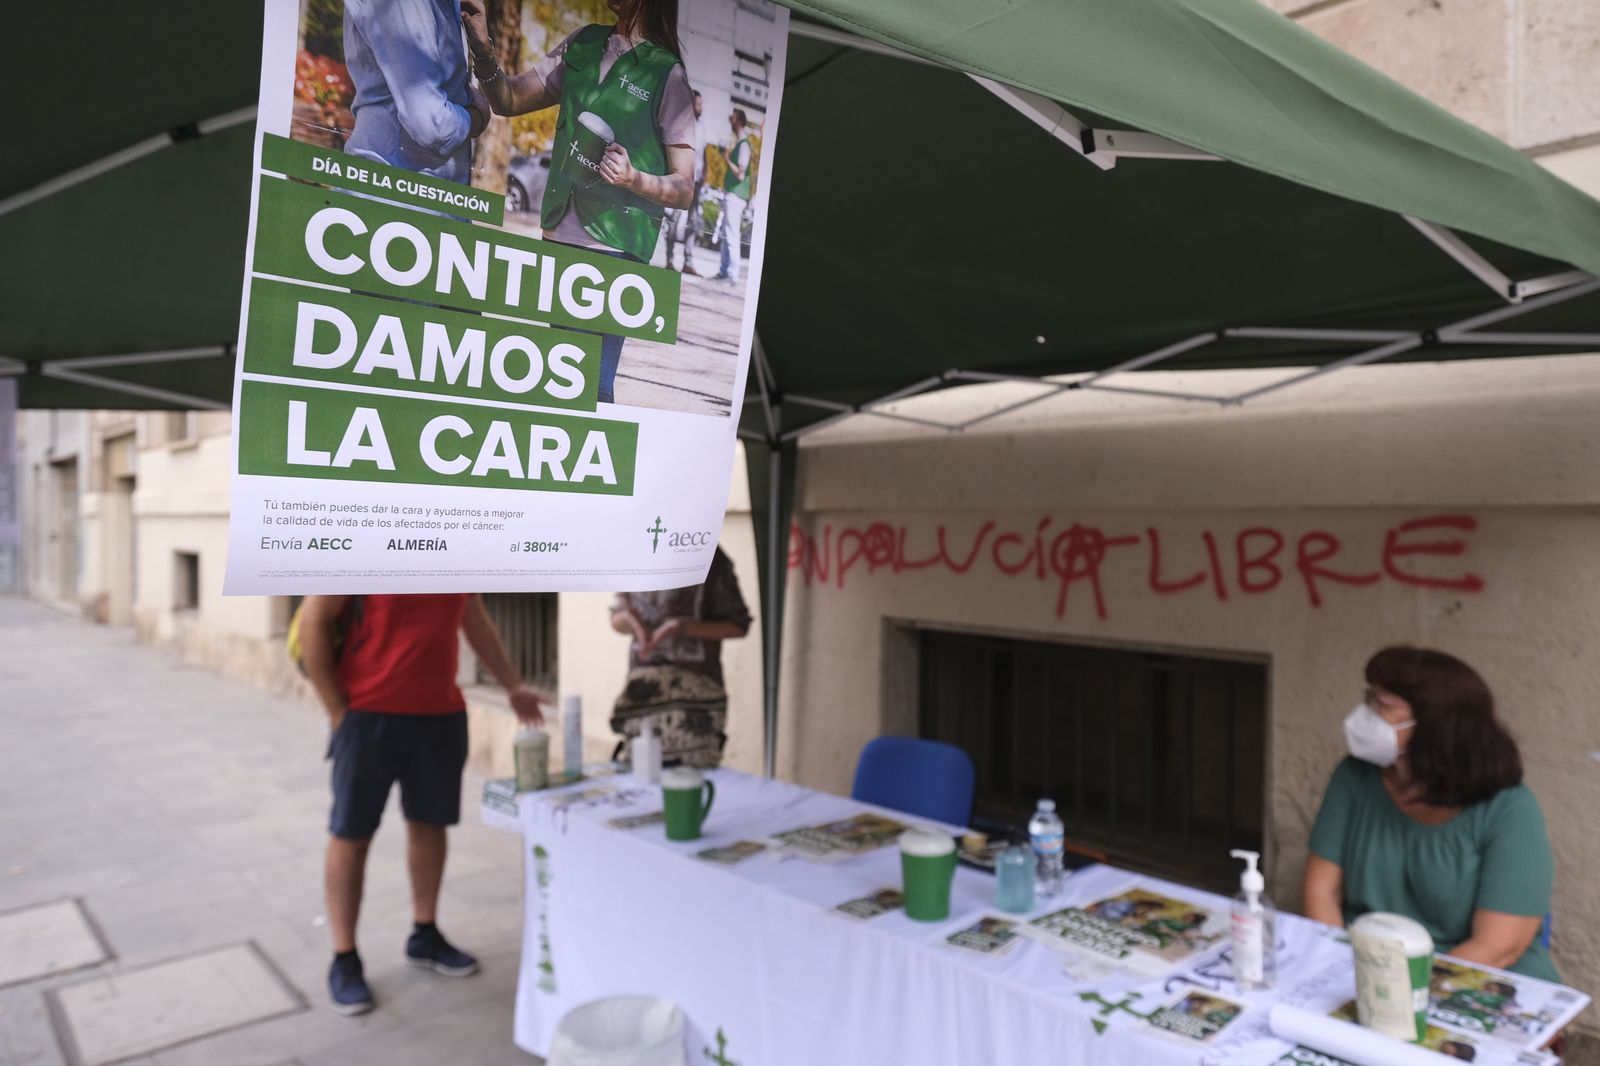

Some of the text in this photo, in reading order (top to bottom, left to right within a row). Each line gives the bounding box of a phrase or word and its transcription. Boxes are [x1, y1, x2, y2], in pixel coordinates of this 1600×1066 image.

[628, 83, 650, 98] aecc
[577, 153, 600, 172] aecc
[312, 156, 490, 214] DÍA DE LA CUESTACIÓN
[304, 207, 665, 334] CONTIGO,
[292, 301, 587, 400] DAMOS
[286, 400, 618, 485] LA CARA
[263, 499, 278, 510] Tú
[281, 501, 326, 512] también
[329, 503, 369, 513] puedes
[371, 504, 388, 514] dar
[391, 505, 399, 514] la
[402, 507, 423, 515] cara
[425, 508, 431, 517] y
[433, 507, 481, 518] ayudarnos
[491, 510, 524, 520] mejorar
[263, 515, 505, 531] la calidad de vida de los afectados por el cáncer:
[260, 536, 302, 550] Envía
[307, 538, 353, 550] AECC
[387, 537, 448, 551] ALMERÍA
[509, 541, 520, 552] al
[668, 531, 711, 547] aecc
[1147, 514, 1485, 608] LIBRE
